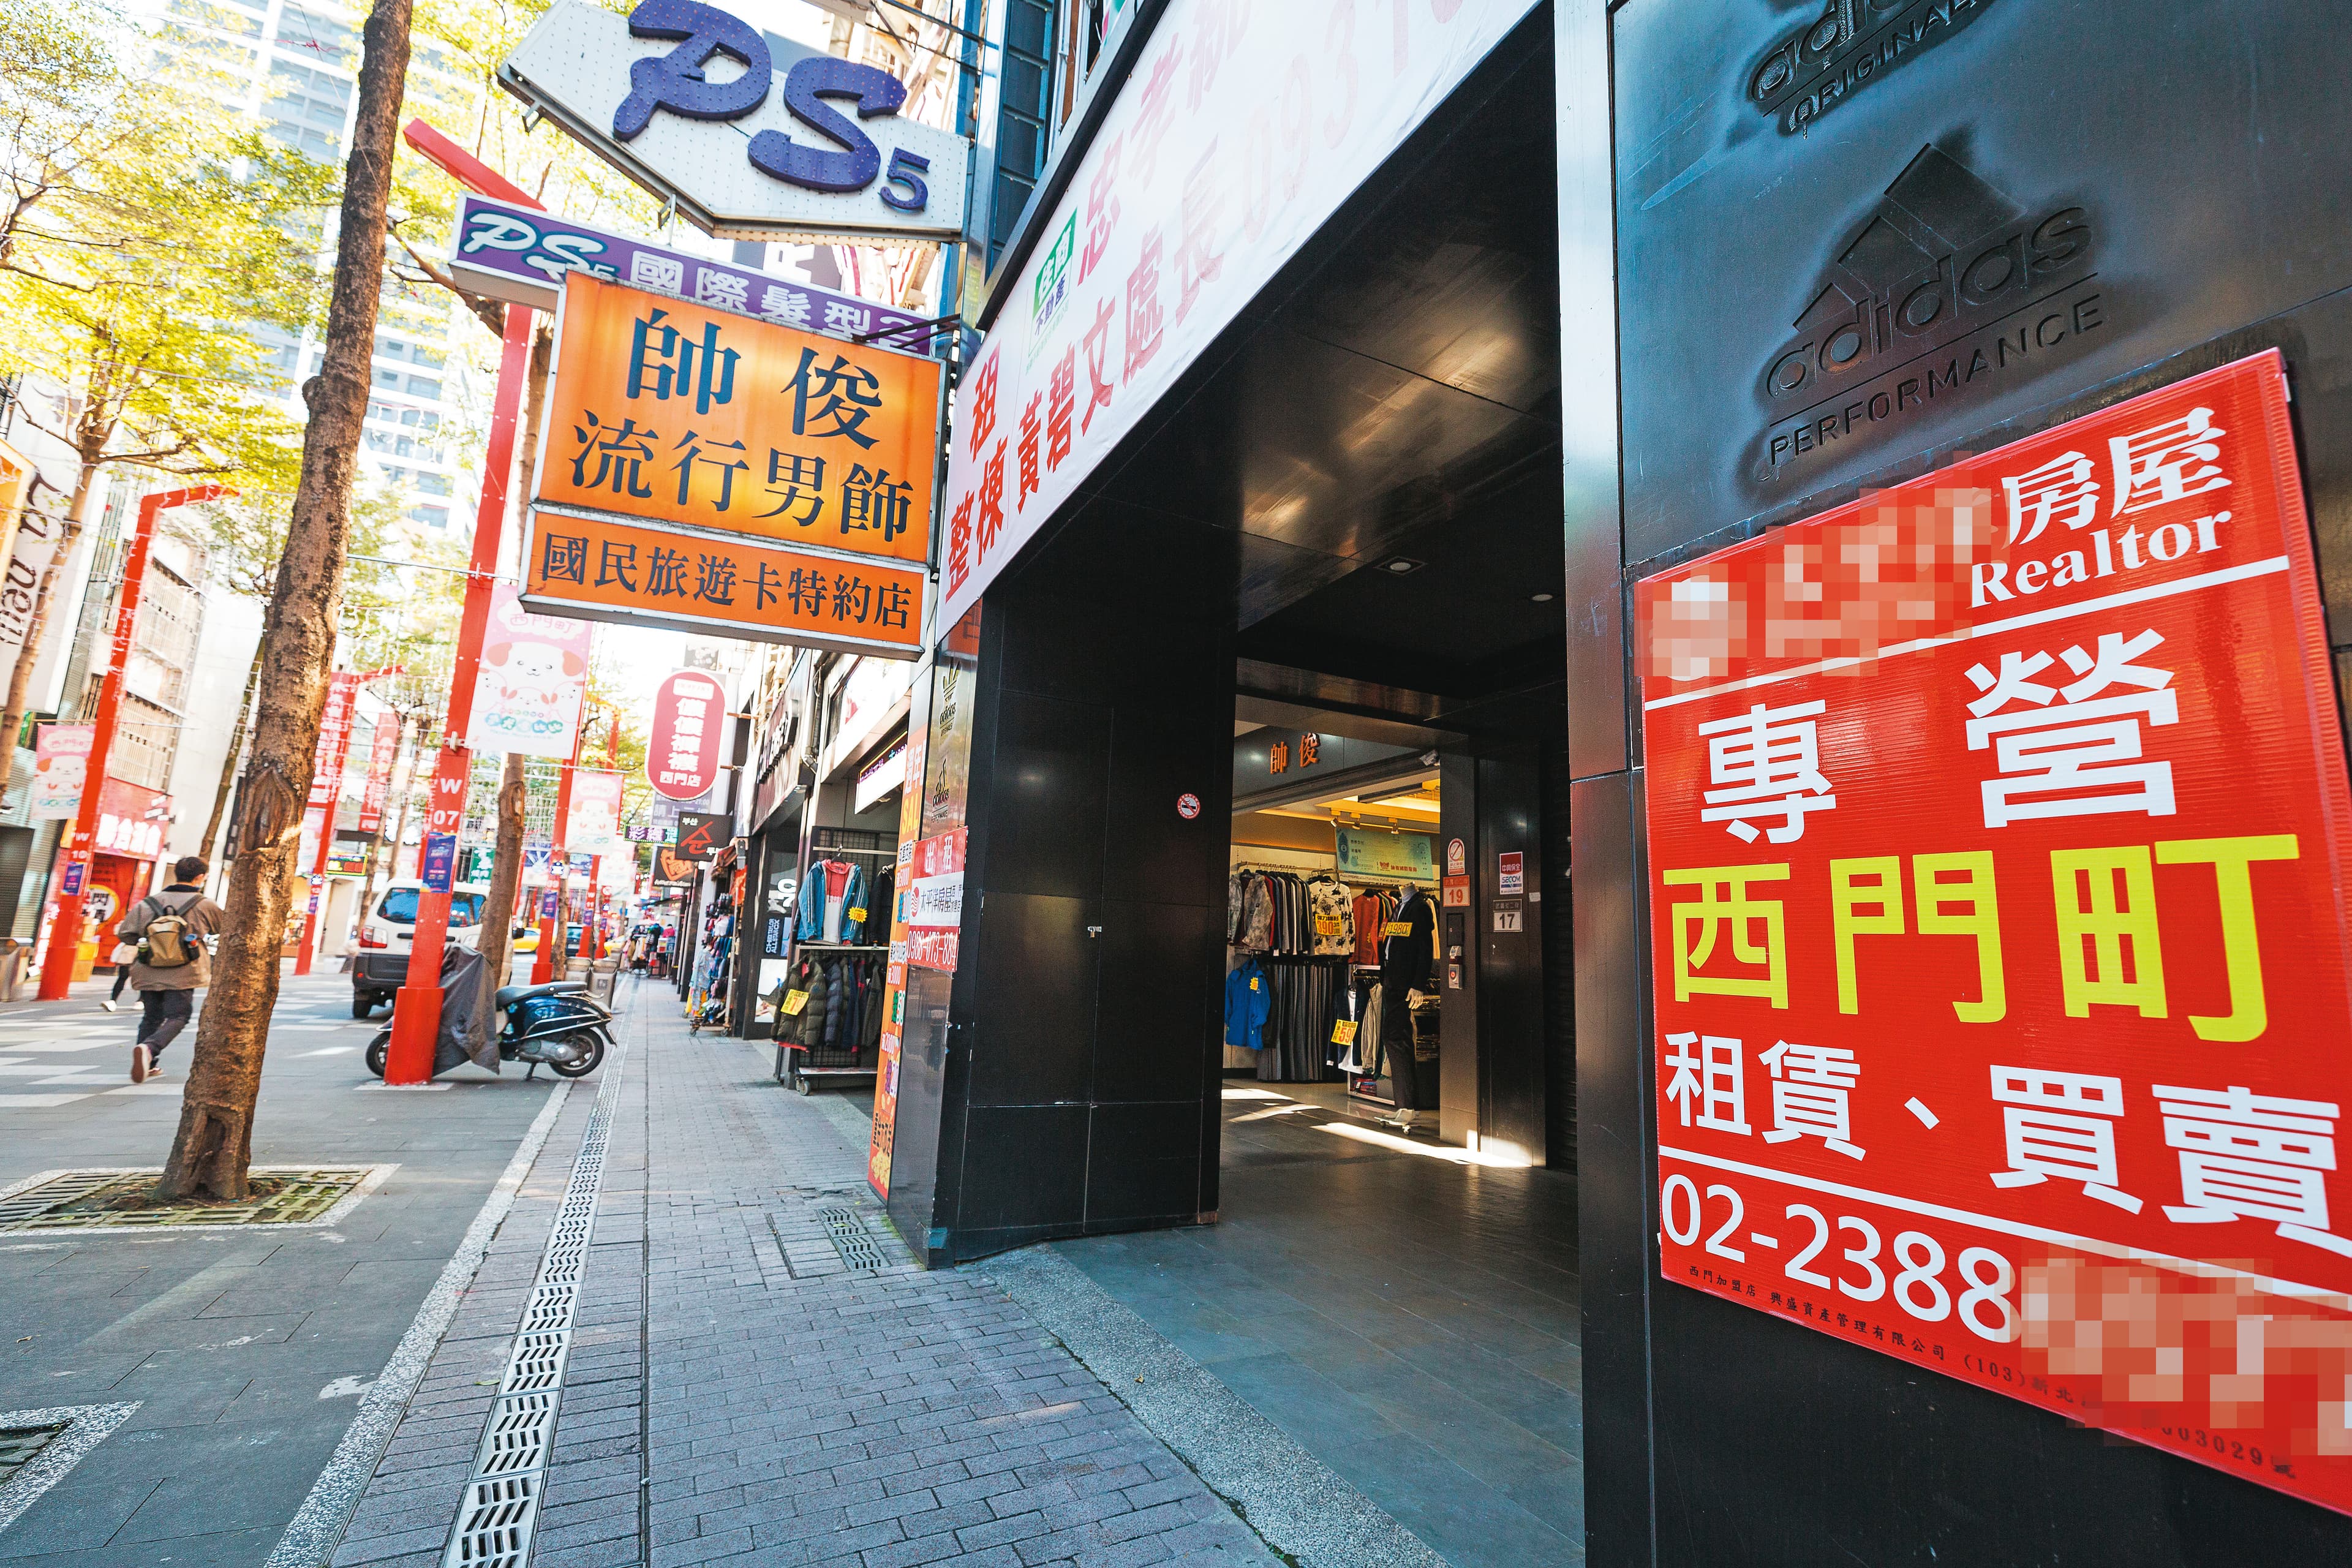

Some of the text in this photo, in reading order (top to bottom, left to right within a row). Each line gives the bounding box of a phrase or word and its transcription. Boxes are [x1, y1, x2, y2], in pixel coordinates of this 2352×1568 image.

[1243, 0, 1461, 244] 0931
[1766, 206, 2094, 399] adidas
[626, 308, 883, 450] 帥俊
[970, 339, 1001, 463] 租
[1768, 294, 2103, 466] PERFORMANCE
[569, 410, 914, 541] 流行男飾
[946, 435, 1008, 603] 整棟
[2000, 406, 2233, 547] 房屋
[542, 532, 911, 629] 國民旅遊卡特約店
[1967, 510, 2233, 609] Realtor
[440, 778, 462, 794] W
[660, 771, 701, 788] 西門店
[1270, 732, 1321, 774] 帥俊
[1698, 628, 2178, 843] 專營
[433, 810, 459, 826] 07
[925, 835, 954, 874] 出租
[907, 930, 957, 967] 0988-073-884
[920, 886, 952, 913] 太平洋房屋
[1317, 921, 1333, 935] 390
[1449, 888, 1463, 904] 19
[1499, 913, 1515, 929] 17
[1663, 834, 2298, 1042] 西門町
[1665, 1030, 2352, 1259] 租賃、買賣
[1689, 1265, 1757, 1297] 西門加盟店
[1770, 1291, 1946, 1361] 興盛資產管理有限公司
[1964, 1354, 2089, 1407] (103)新北
